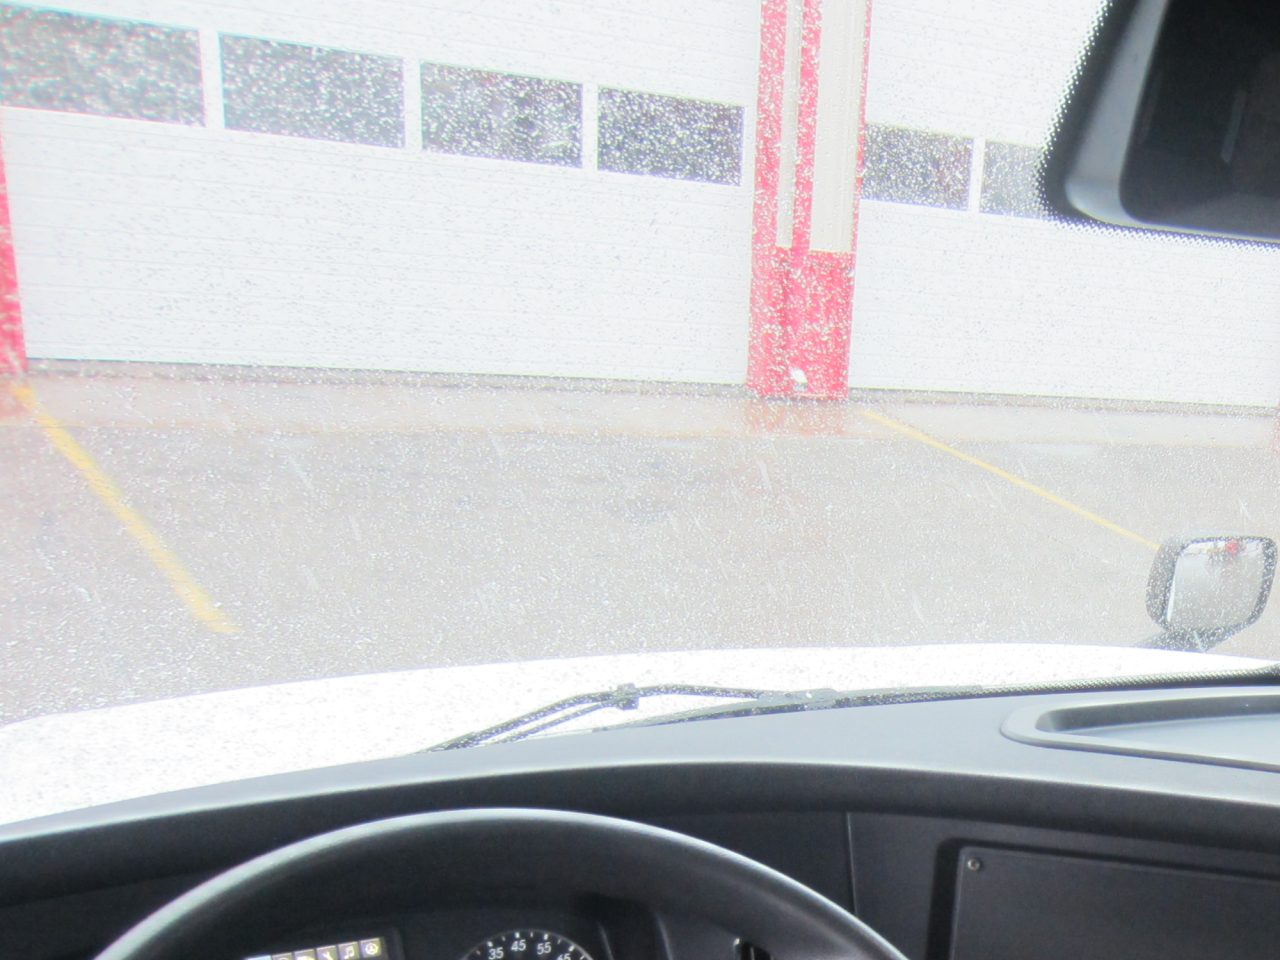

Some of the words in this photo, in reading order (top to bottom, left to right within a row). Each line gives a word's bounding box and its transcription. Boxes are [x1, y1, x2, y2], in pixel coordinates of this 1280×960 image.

[511, 939, 527, 951] 45
[537, 942, 552, 954] 55
[488, 948, 504, 960] 35
